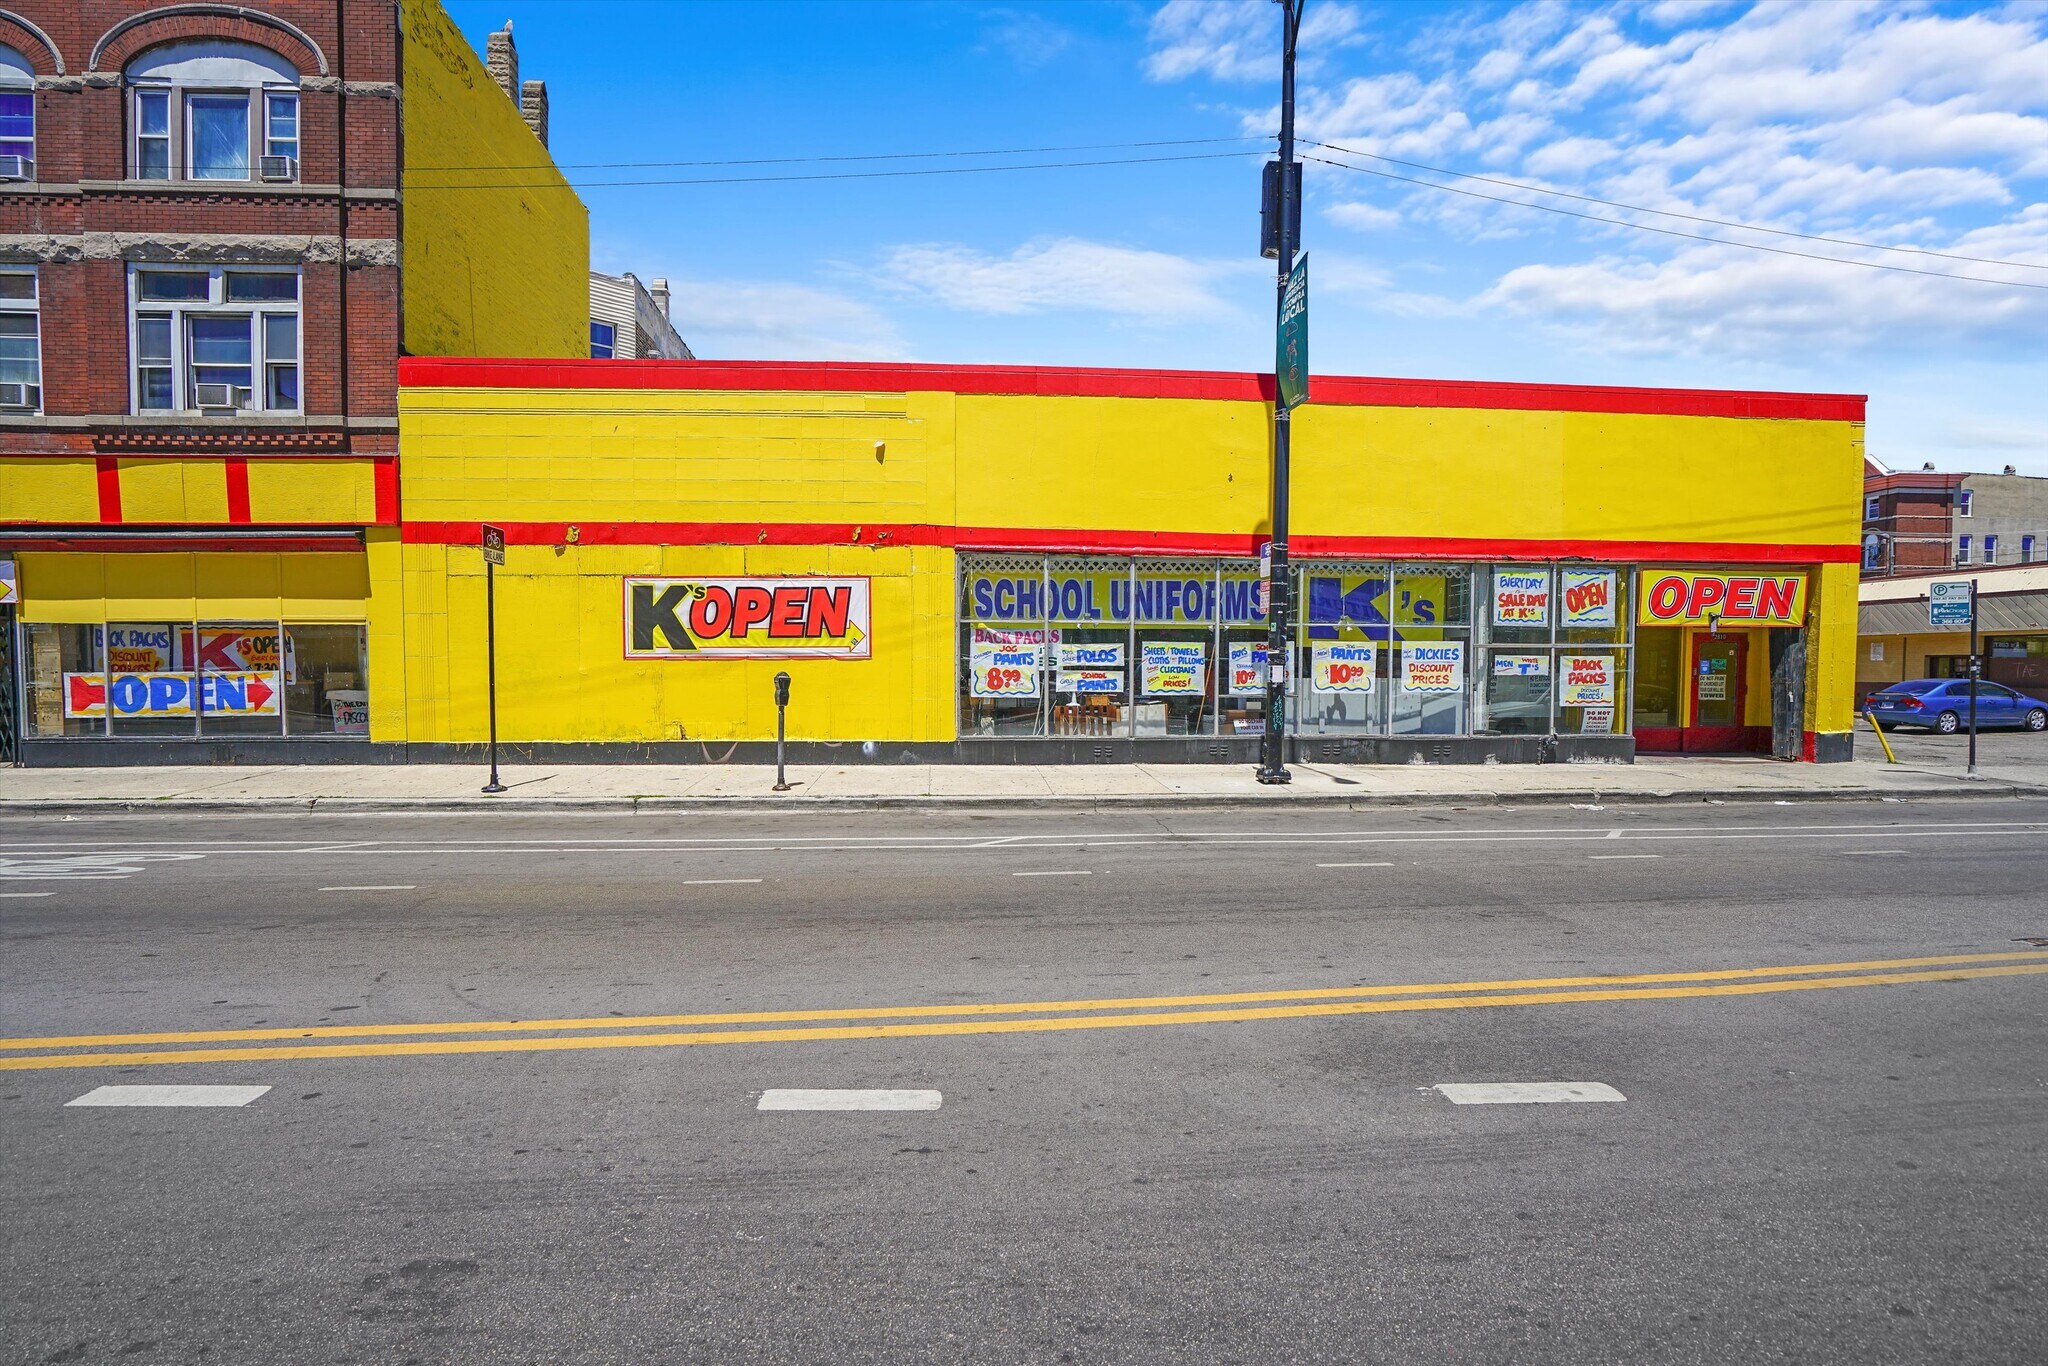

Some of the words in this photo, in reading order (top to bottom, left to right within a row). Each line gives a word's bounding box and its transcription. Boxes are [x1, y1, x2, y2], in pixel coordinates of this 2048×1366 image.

[1281, 299, 1305, 326] LOCAL
[974, 578, 1101, 621] SCHOOL
[1111, 579, 1266, 621] UNIFORMS
[1498, 593, 1525, 607] SALE
[1526, 593, 1548, 607] DAY
[1565, 580, 1608, 613] OPEN
[1648, 575, 1799, 620] OPEN
[689, 586, 851, 638] OPEN
[1502, 608, 1515, 618] AT
[95, 628, 126, 648] BCK
[130, 630, 170, 649] PACKS
[975, 629, 1012, 644] BACK
[252, 636, 293, 653] OPEN
[1170, 646, 1199, 656] TOWELS
[109, 651, 152, 662] DISCOUNT
[993, 652, 1035, 666] PANTS
[1076, 648, 1118, 663] POLOS
[1231, 647, 1248, 659] BOYS
[1330, 647, 1372, 661] PANTS
[1415, 647, 1460, 661] DICKIES
[1177, 656, 1205, 665] PILLOWS
[1572, 659, 1602, 671] BACK
[1081, 671, 1107, 679] SCHOOL
[1408, 663, 1455, 674] DISCOUNT
[1076, 678, 1118, 691] PANTS
[1411, 674, 1450, 684] PRICES
[1568, 672, 1607, 685] PACKS
[113, 675, 247, 713] OPEN
